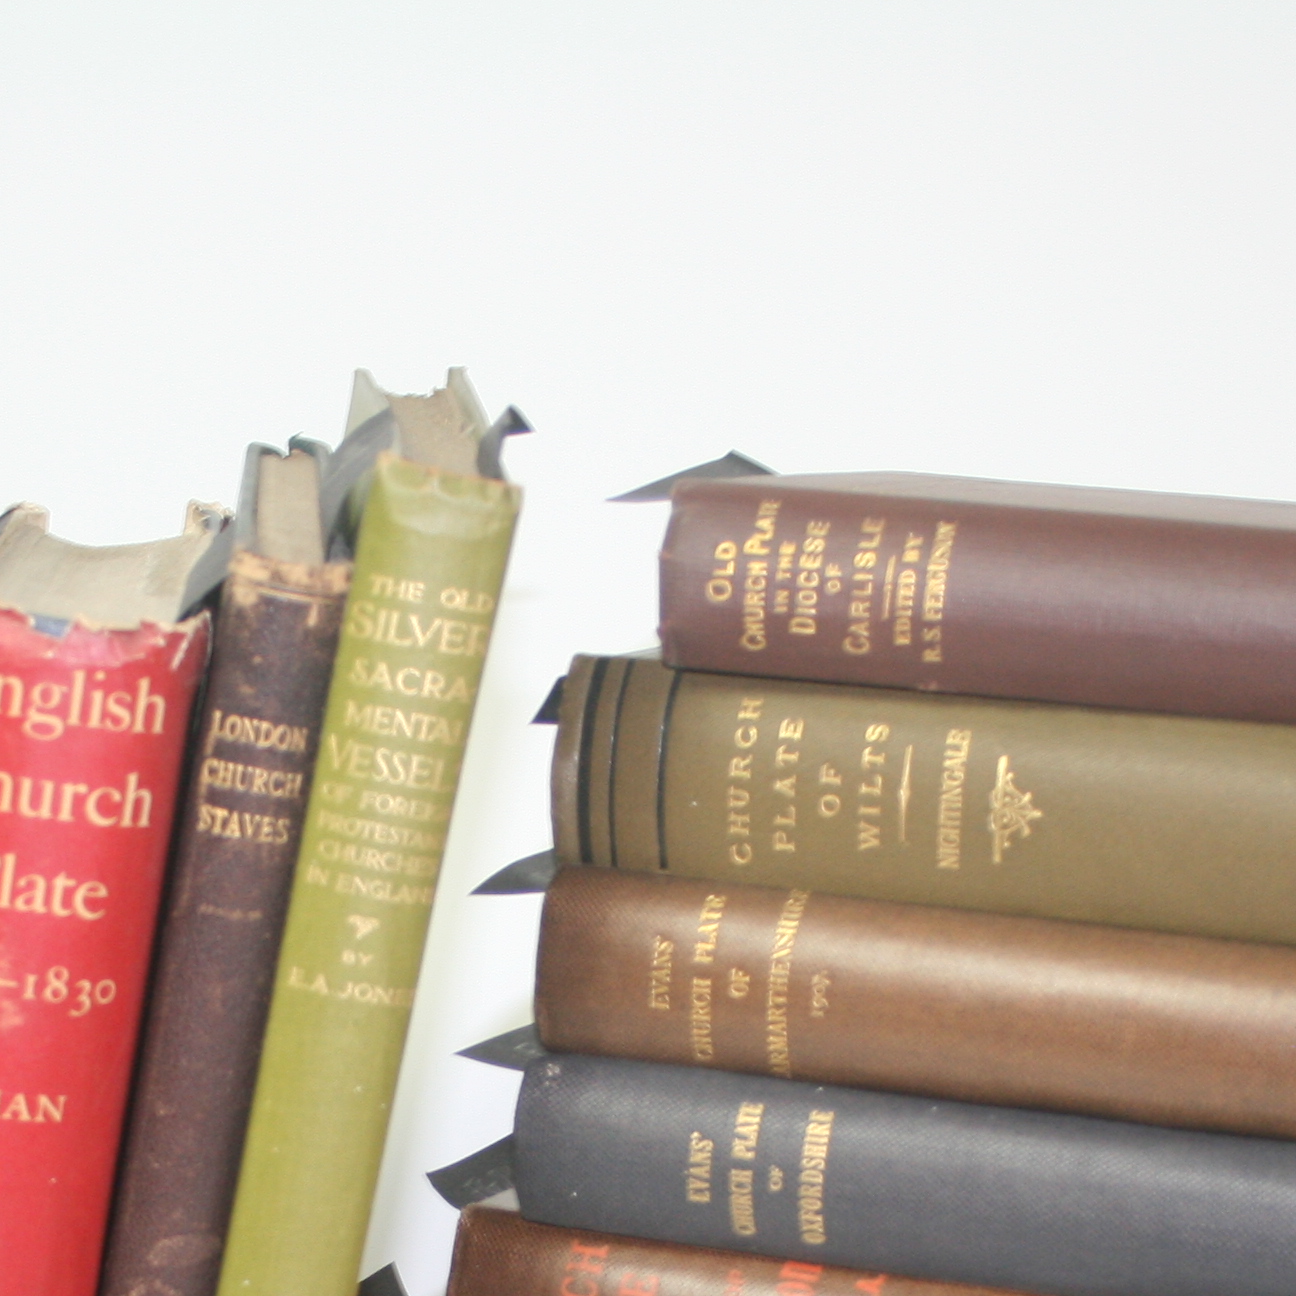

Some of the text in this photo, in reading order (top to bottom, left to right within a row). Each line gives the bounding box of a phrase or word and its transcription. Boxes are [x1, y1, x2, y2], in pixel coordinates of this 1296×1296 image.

[370, 574, 495, 613] THE OLD
[740, 561, 768, 650] CHURCH
[774, 541, 796, 613] IN THE
[788, 521, 831, 634] DIOCESE
[825, 562, 842, 594] OF
[842, 516, 884, 654] CARLISLE
[894, 533, 923, 645] EDITED BY
[204, 757, 304, 798] CHURCH
[212, 709, 308, 751] LONDON
[196, 803, 291, 846] STAVES
[727, 696, 764, 865] CHURCH
[772, 717, 805, 853] PLATE
[818, 763, 842, 818] OF
[857, 723, 890, 850] WILTS
[936, 729, 972, 869] NIGHTINGALE
[341, 948, 375, 966] BY
[689, 894, 727, 1061] CHURCH PLATE
[728, 967, 750, 999] OF
[765, 889, 809, 1077] ARMARTHENSHIRE
[728, 1101, 764, 1236] CHURCH PLATE
[768, 1165, 783, 1192] OF
[797, 1109, 835, 1244] OXFORDSHIRE
